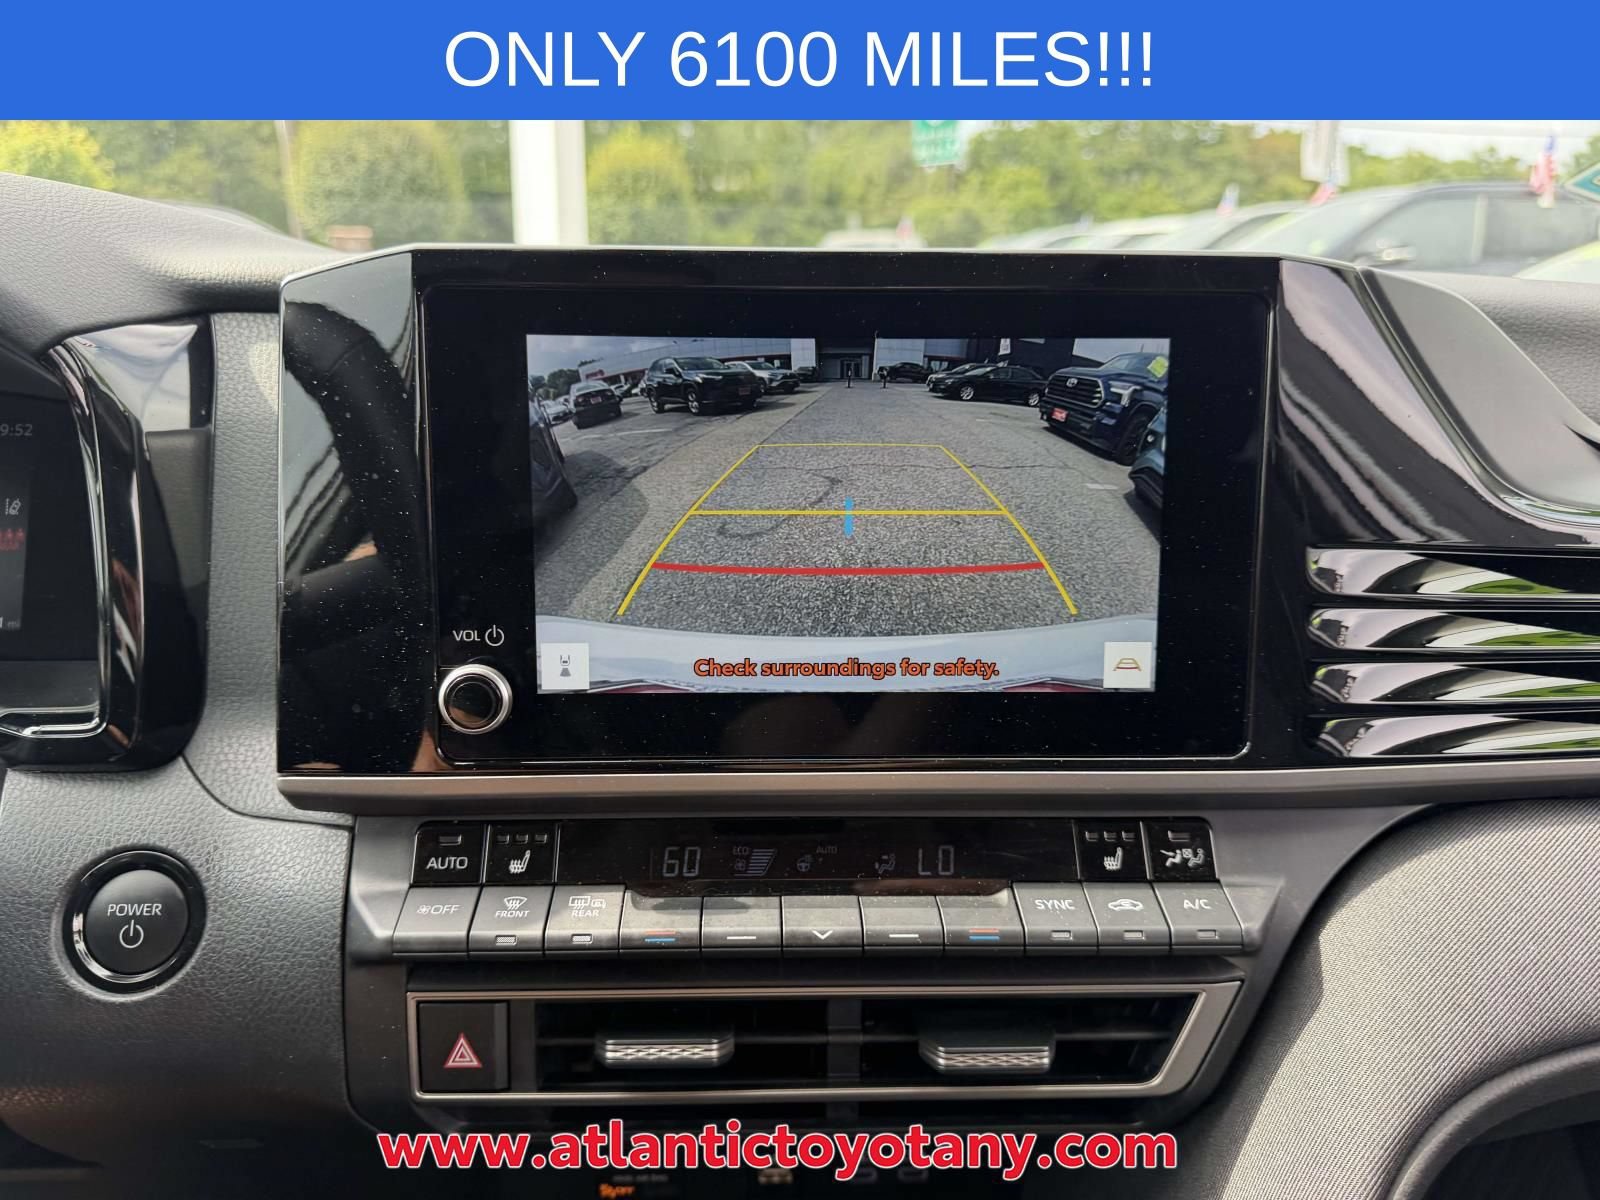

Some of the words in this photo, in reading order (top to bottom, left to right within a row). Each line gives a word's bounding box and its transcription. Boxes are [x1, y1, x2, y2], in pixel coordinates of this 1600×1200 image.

[452, 630, 481, 642] VOL
[693, 658, 757, 677] Check
[761, 657, 896, 679] surroundings
[900, 658, 930, 677] for
[933, 658, 1000, 680] safety.
[425, 856, 468, 870] AUTO
[107, 903, 162, 917] POWER
[430, 904, 461, 915] OFF
[1034, 899, 1075, 911] SYNC
[1182, 899, 1209, 910] A/C
[495, 910, 530, 918] FRONT
[571, 909, 600, 918] REAR
